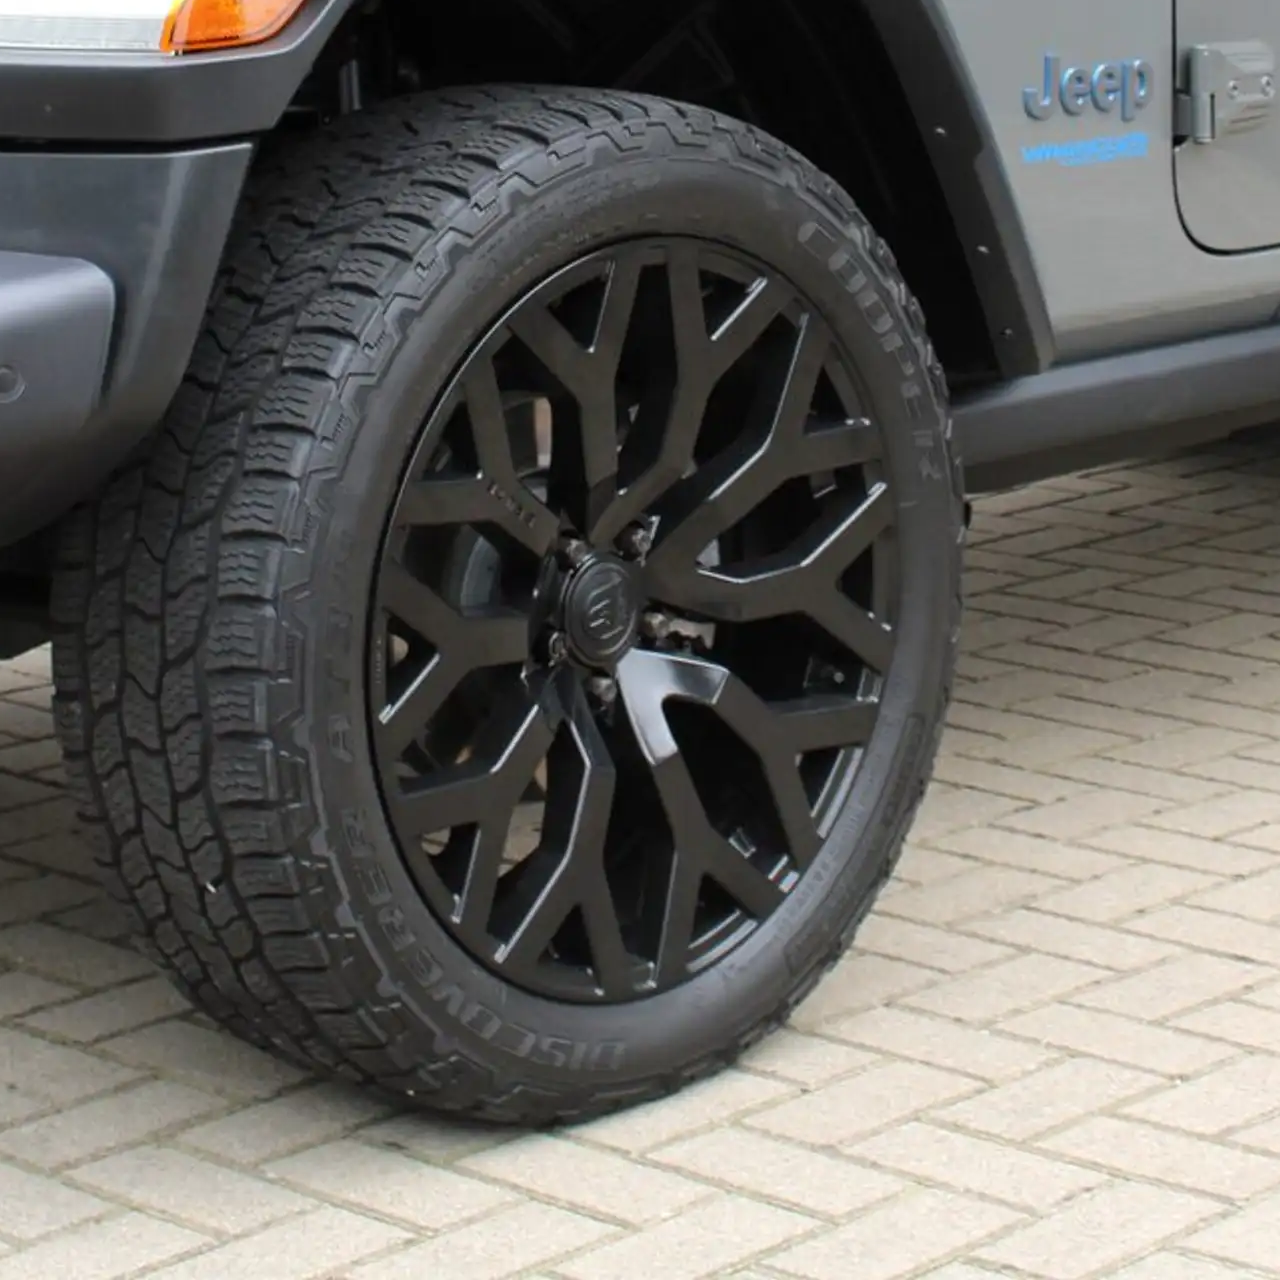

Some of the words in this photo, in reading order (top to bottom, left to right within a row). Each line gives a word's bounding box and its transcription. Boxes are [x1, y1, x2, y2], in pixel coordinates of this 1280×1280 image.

[1023, 54, 1153, 122] Jeep
[796, 220, 946, 482] COOPER
[340, 806, 627, 1073] DISCOVERER
